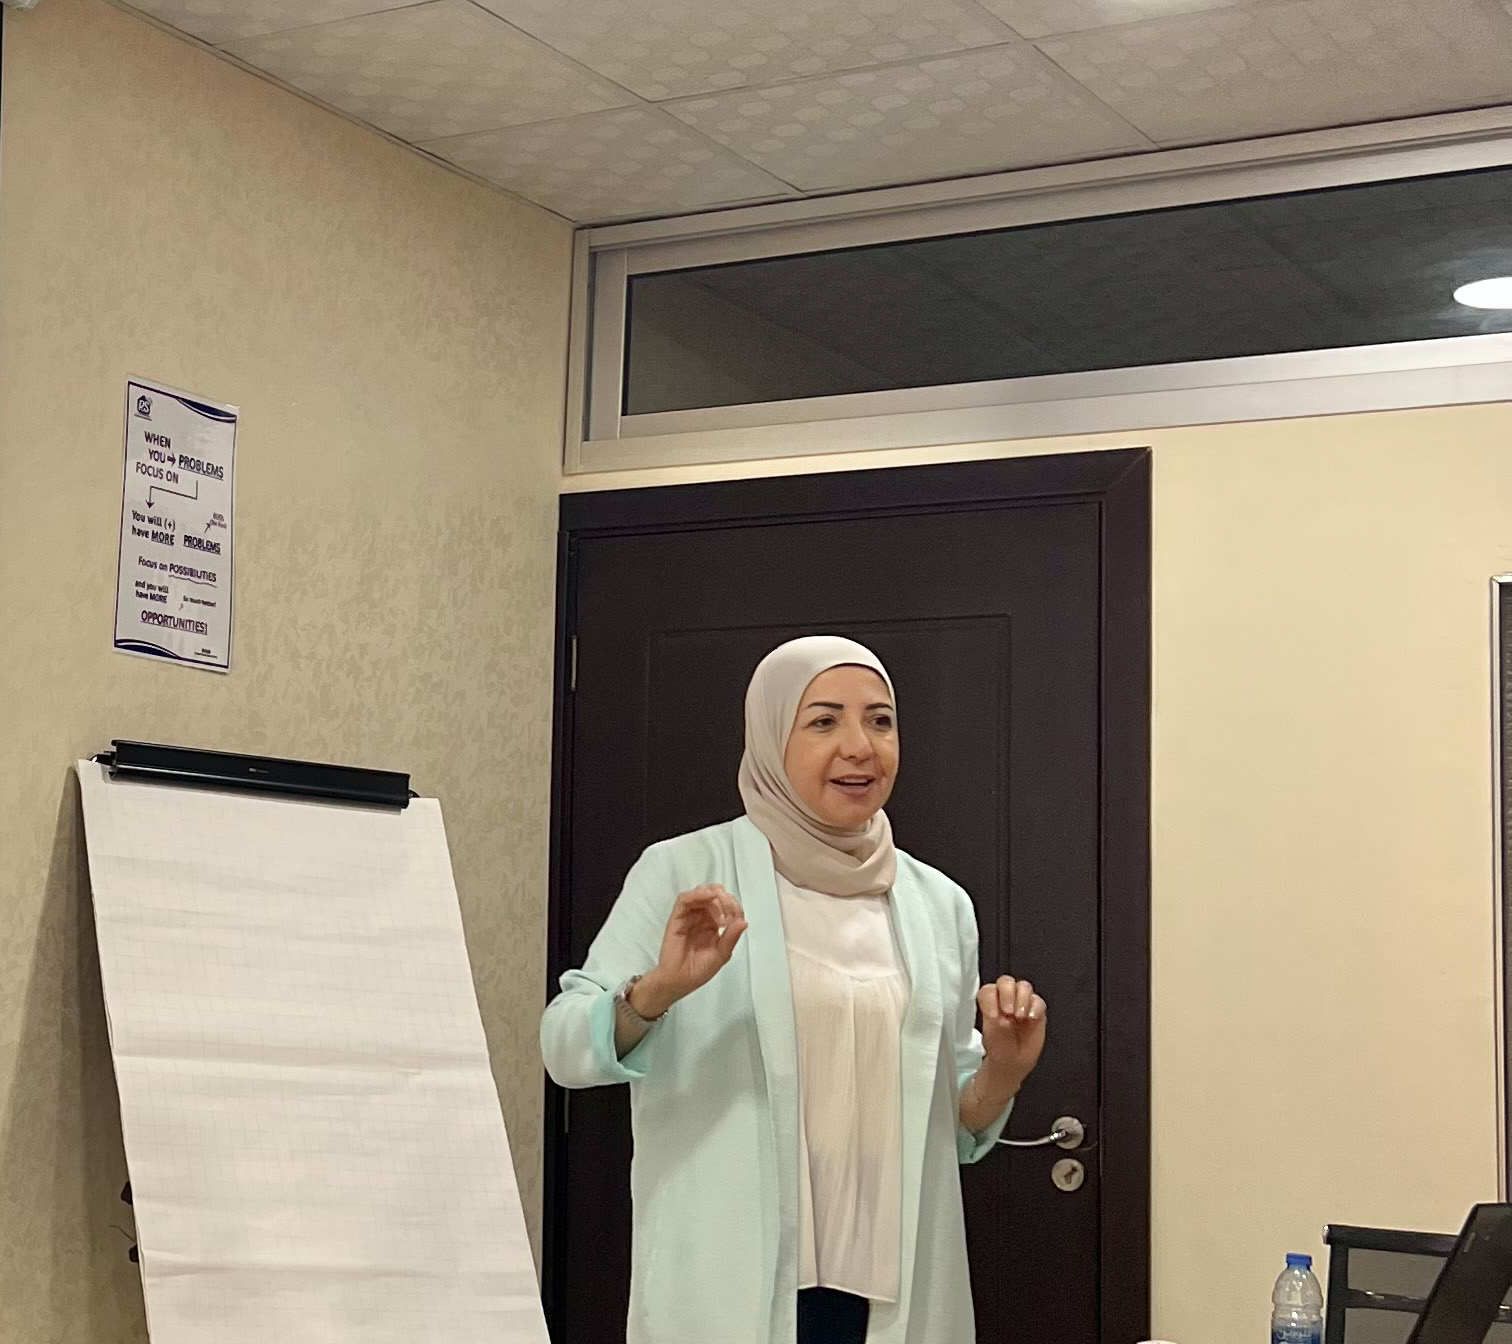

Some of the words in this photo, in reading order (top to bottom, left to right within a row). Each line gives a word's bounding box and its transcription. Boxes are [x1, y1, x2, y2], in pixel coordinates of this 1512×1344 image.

[144, 431, 172, 449] WHEN
[136, 462, 164, 480] FOCUS
[166, 470, 179, 484] ON
[148, 448, 166, 464] YOU
[178, 454, 224, 480] PROBLEMS
[132, 510, 146, 523] You
[147, 515, 162, 527] will
[131, 525, 150, 539] have
[151, 530, 175, 545] MORE
[183, 534, 221, 554] PROBLEMS
[138, 556, 158, 570] Focus
[169, 563, 217, 583] POSSIBILITIES
[141, 609, 208, 634] OPPORTUNITIES!
